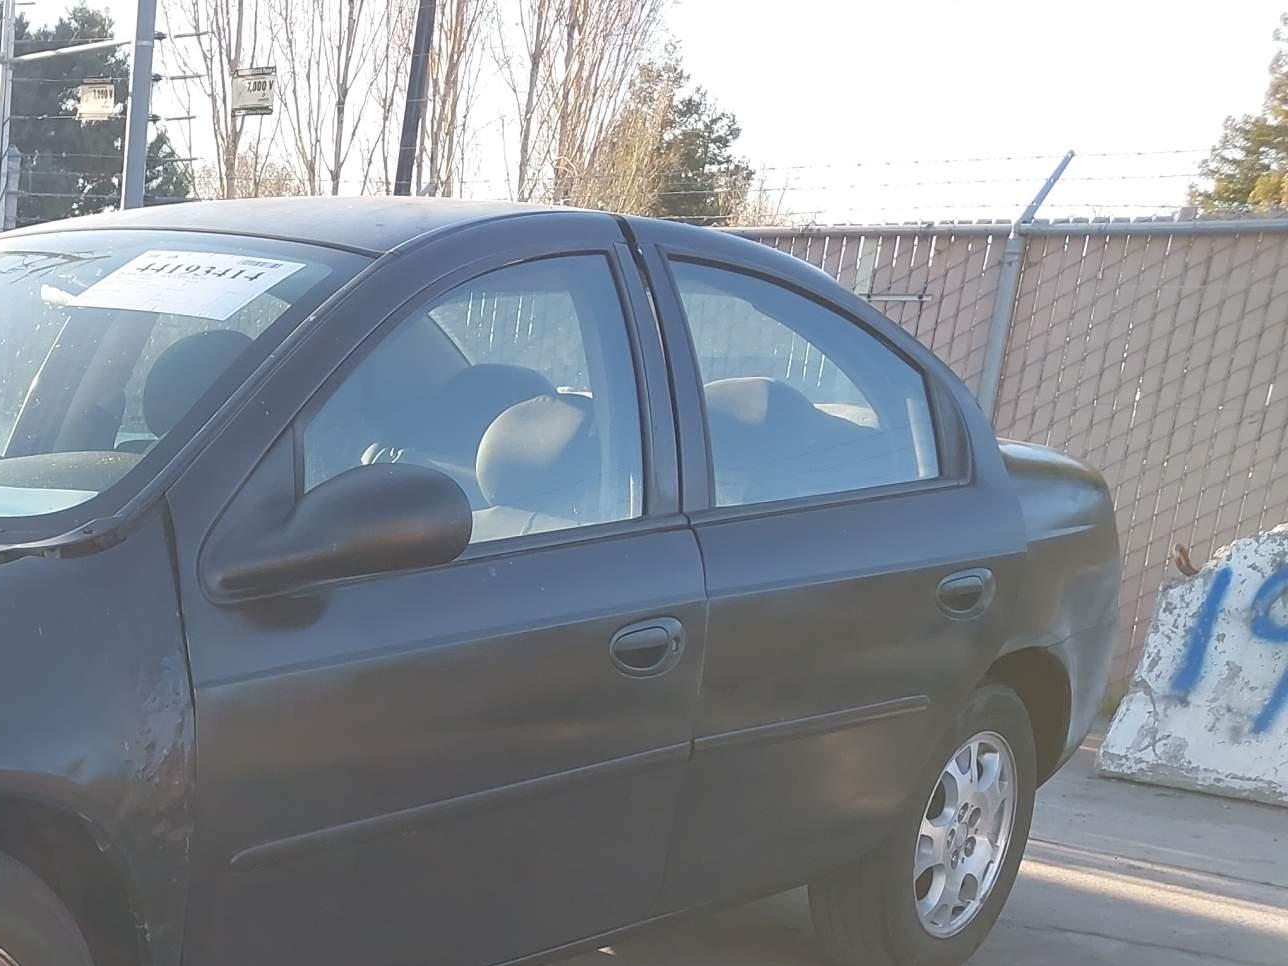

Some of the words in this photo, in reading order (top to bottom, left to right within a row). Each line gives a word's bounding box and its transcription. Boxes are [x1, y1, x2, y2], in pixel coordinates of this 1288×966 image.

[247, 80, 267, 93] 7,000
[269, 79, 274, 90] V
[136, 262, 266, 282] 44193414
